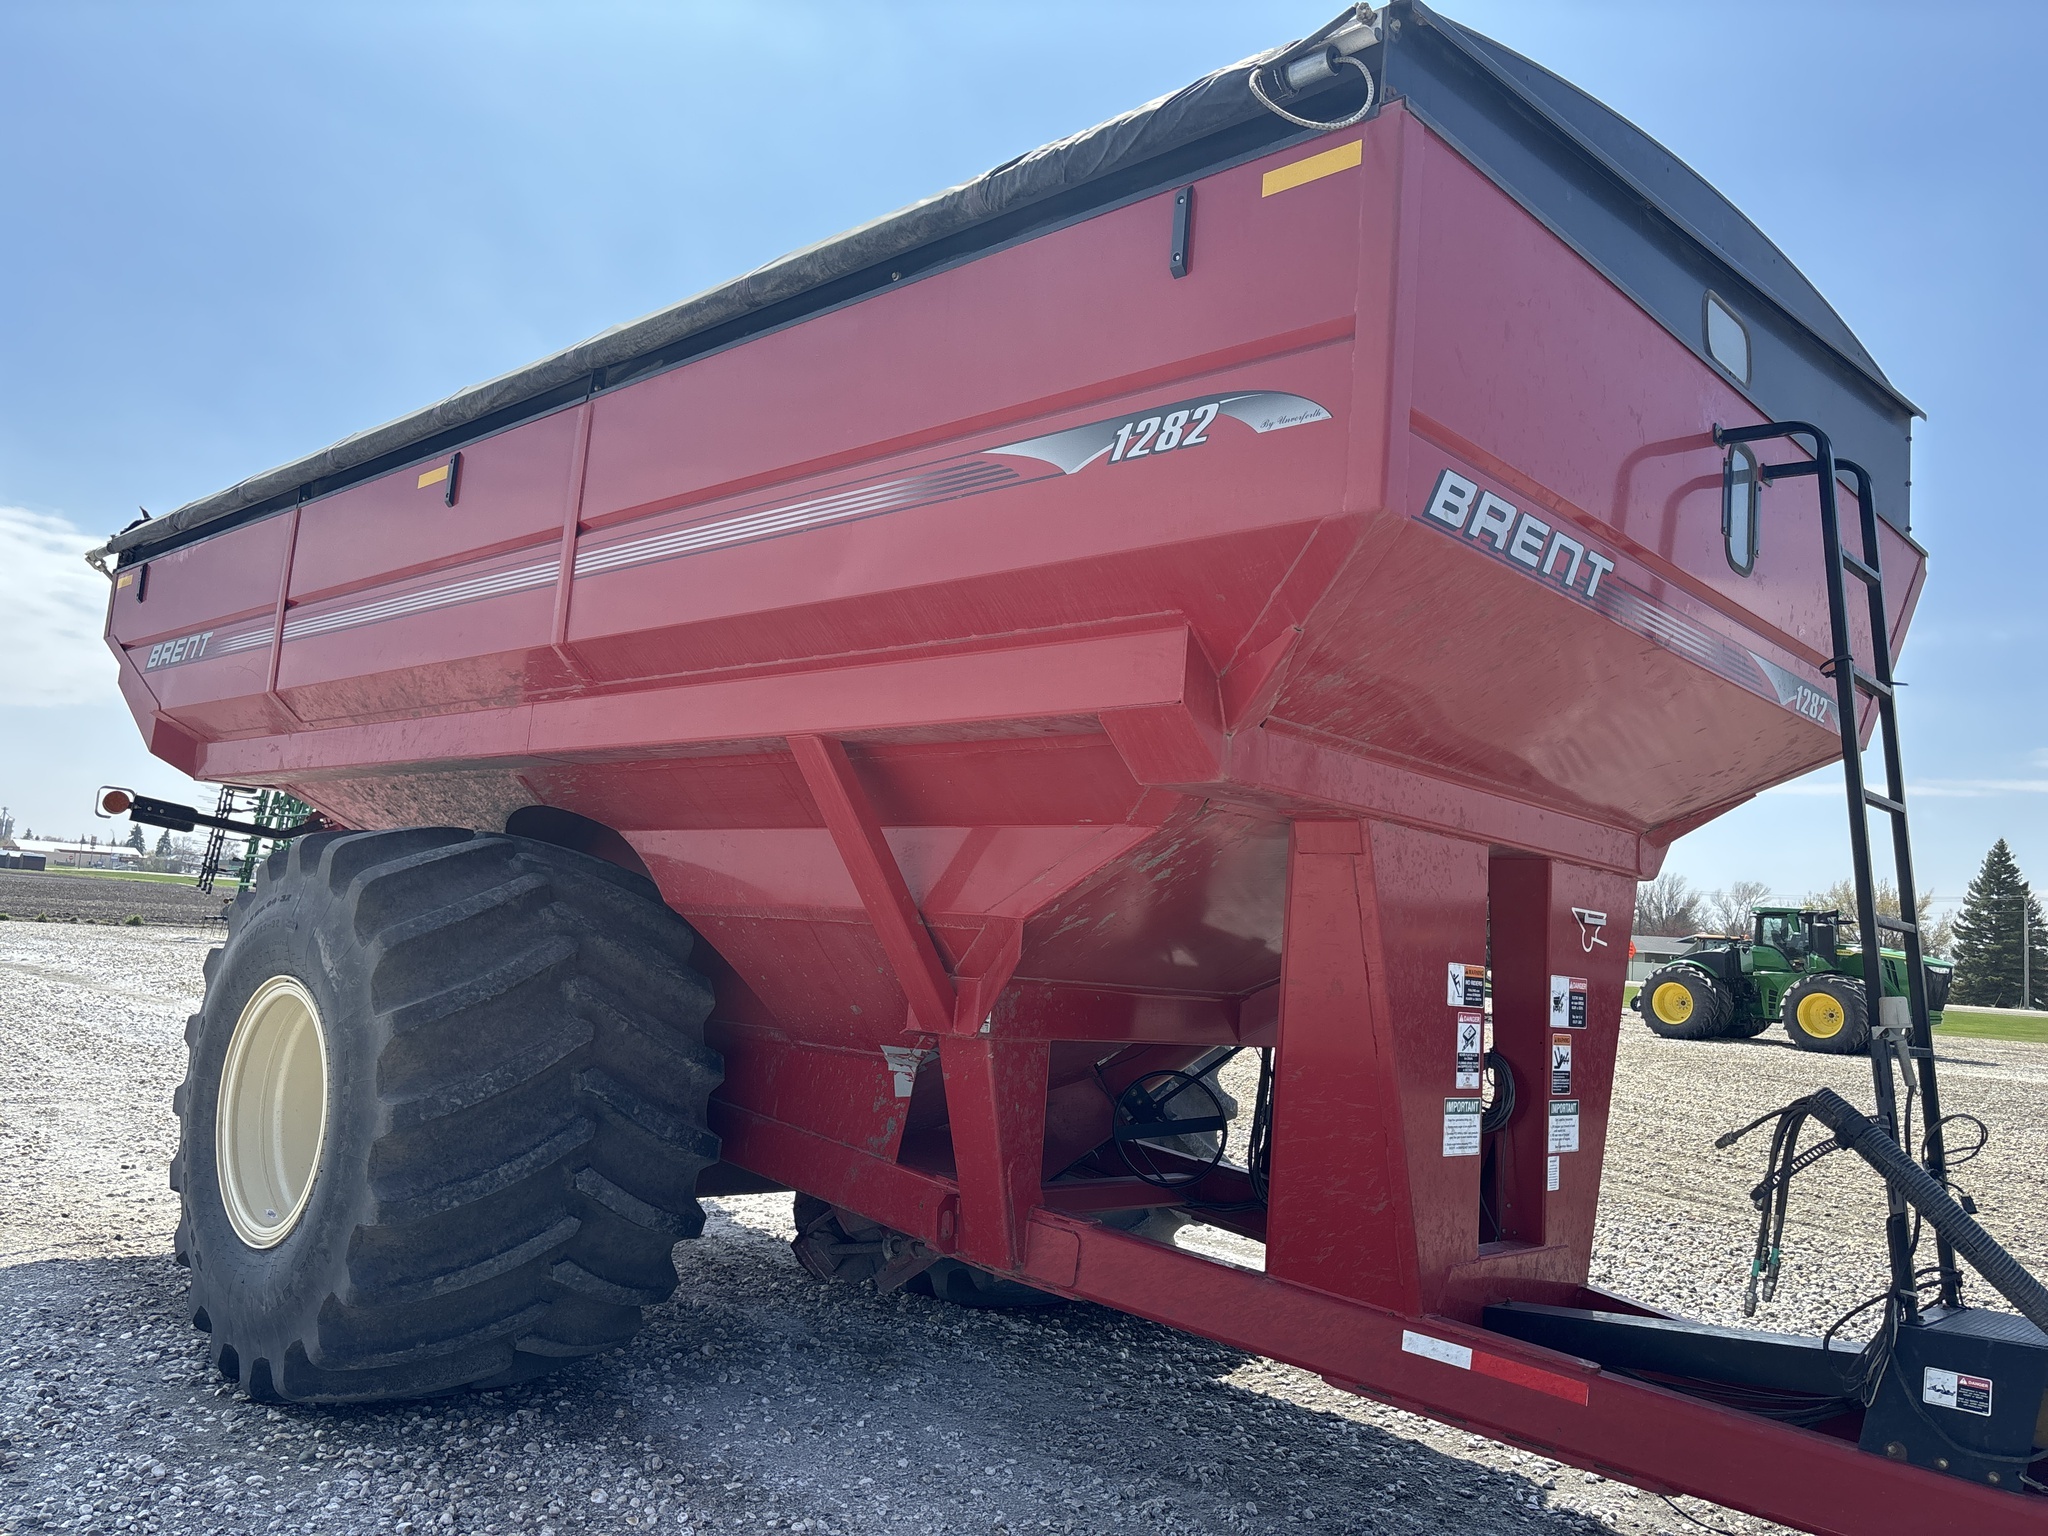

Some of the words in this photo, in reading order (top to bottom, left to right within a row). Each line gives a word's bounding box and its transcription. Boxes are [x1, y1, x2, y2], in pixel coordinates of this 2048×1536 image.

[1260, 418, 1274, 430] By
[1109, 401, 1220, 463] 1282
[1425, 468, 1615, 598] BRENT
[146, 631, 214, 669] BRENT
[1795, 685, 1828, 723] 1282
[1571, 981, 1587, 990] DANGER
[1463, 1015, 1480, 1023] DANGER
[1446, 1101, 1479, 1113] IMPORTANT
[1551, 1102, 1577, 1114] IMPORTANT
[1968, 1380, 1989, 1388] DANGER
